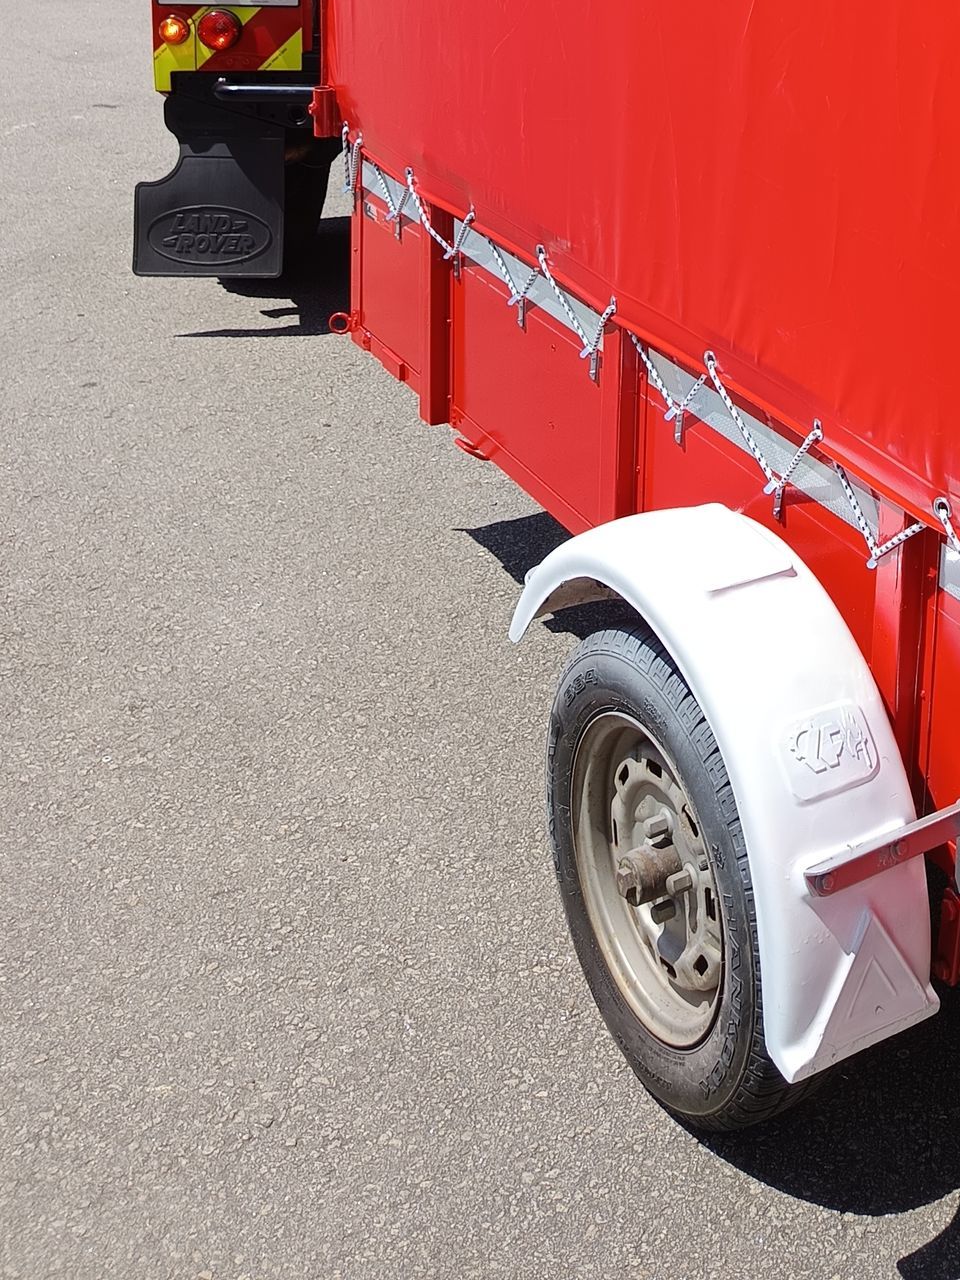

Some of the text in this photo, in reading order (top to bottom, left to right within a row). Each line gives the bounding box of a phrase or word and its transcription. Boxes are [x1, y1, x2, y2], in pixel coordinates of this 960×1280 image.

[168, 213, 231, 233] LAND
[175, 232, 255, 254] ROVER
[699, 893, 743, 1100] HANKOOK
